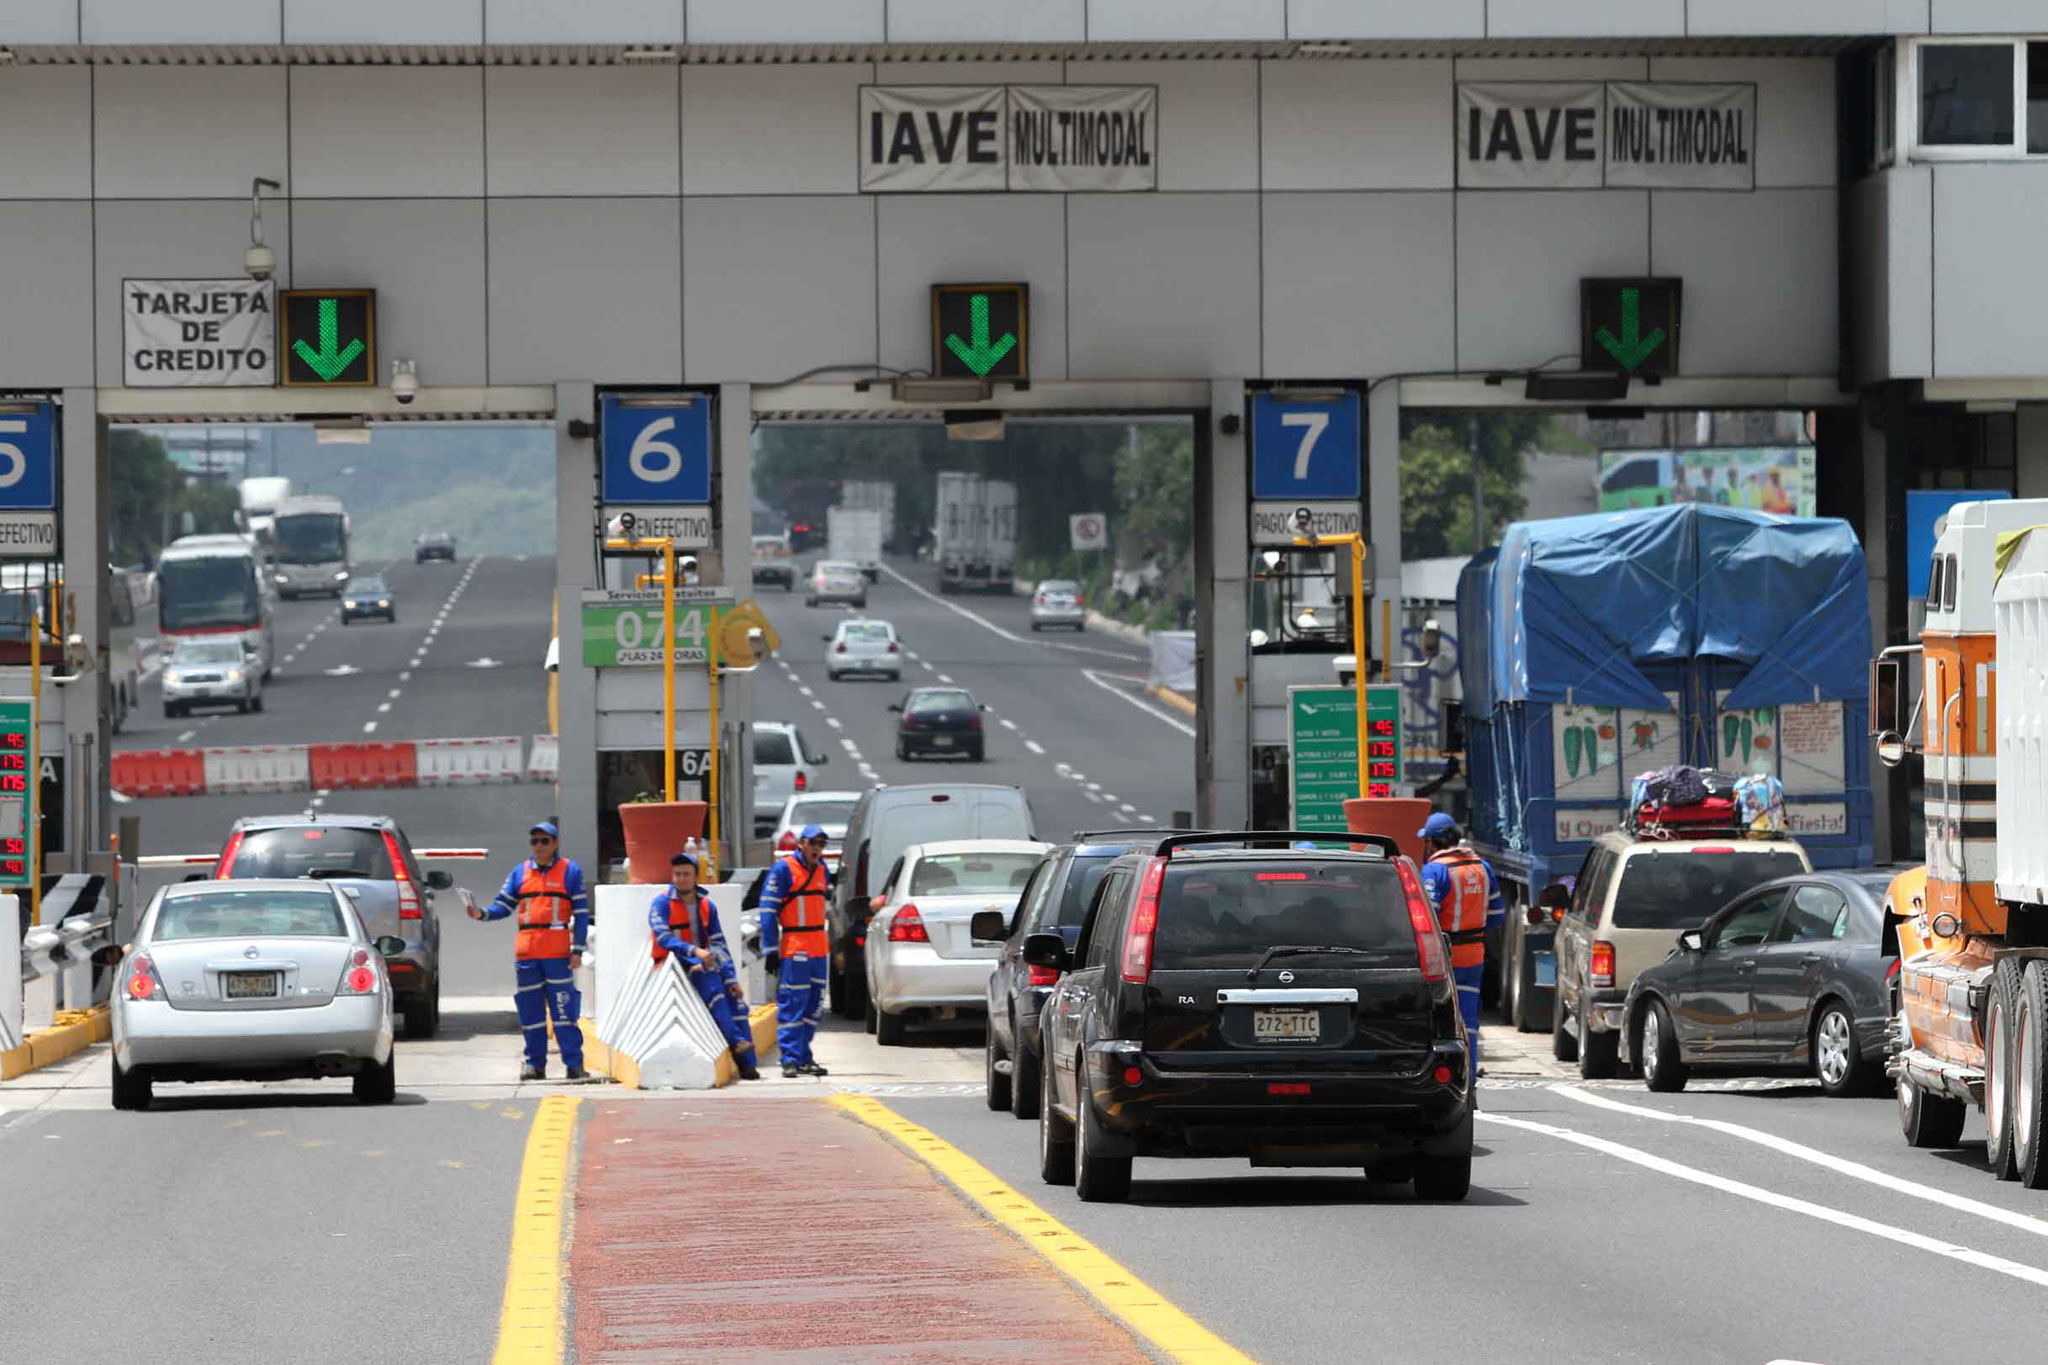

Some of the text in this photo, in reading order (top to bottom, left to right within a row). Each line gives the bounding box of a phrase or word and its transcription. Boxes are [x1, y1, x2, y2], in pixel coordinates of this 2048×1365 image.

[871, 110, 1150, 166] IAVE MULTIMODAL
[1468, 107, 1748, 164] IAVE MULTIMODAL
[131, 291, 269, 314] TARJETA
[182, 321, 220, 342] DE
[134, 349, 267, 371] CREDITO
[629, 416, 682, 482] 6
[1281, 412, 1330, 480] 7
[654, 517, 708, 537] EFECTIVO
[1311, 512, 1359, 534] FECTIVO
[616, 610, 705, 648] 074
[1179, 996, 1195, 1004] RA
[1257, 1016, 1316, 1031] 272-TTC
